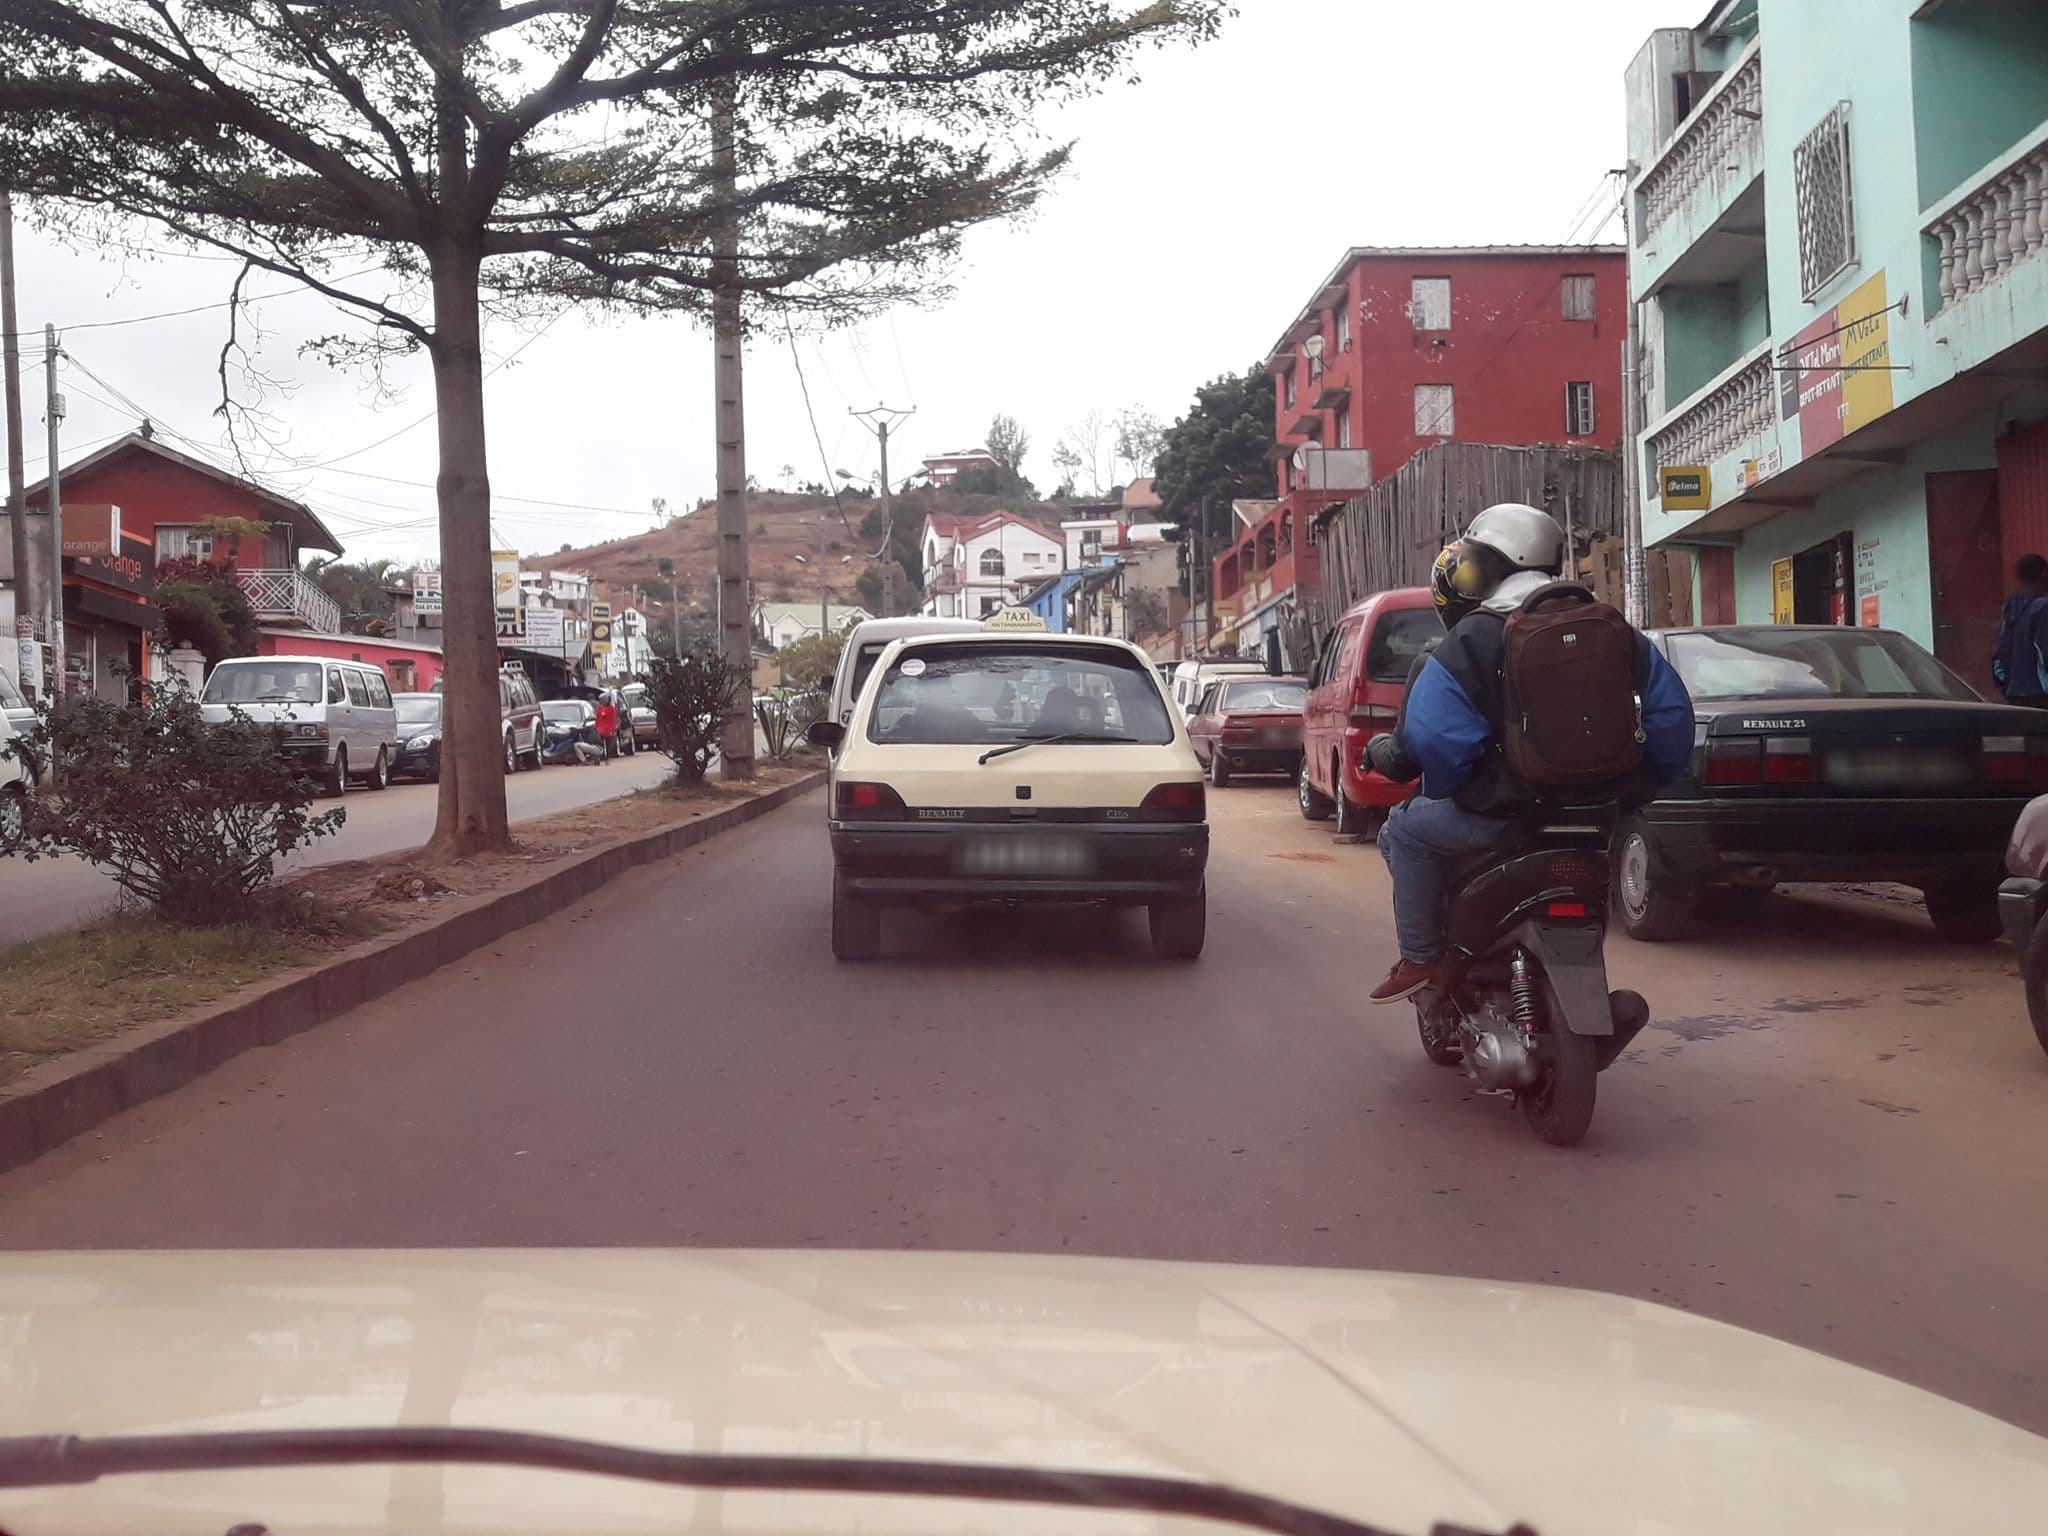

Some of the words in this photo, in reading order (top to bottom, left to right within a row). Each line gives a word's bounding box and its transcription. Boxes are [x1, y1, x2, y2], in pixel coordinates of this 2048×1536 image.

[63, 539, 107, 550] orange
[1004, 611, 1030, 621] TAXI
[1743, 719, 1792, 729] RENAULT
[1793, 719, 1806, 728] 21
